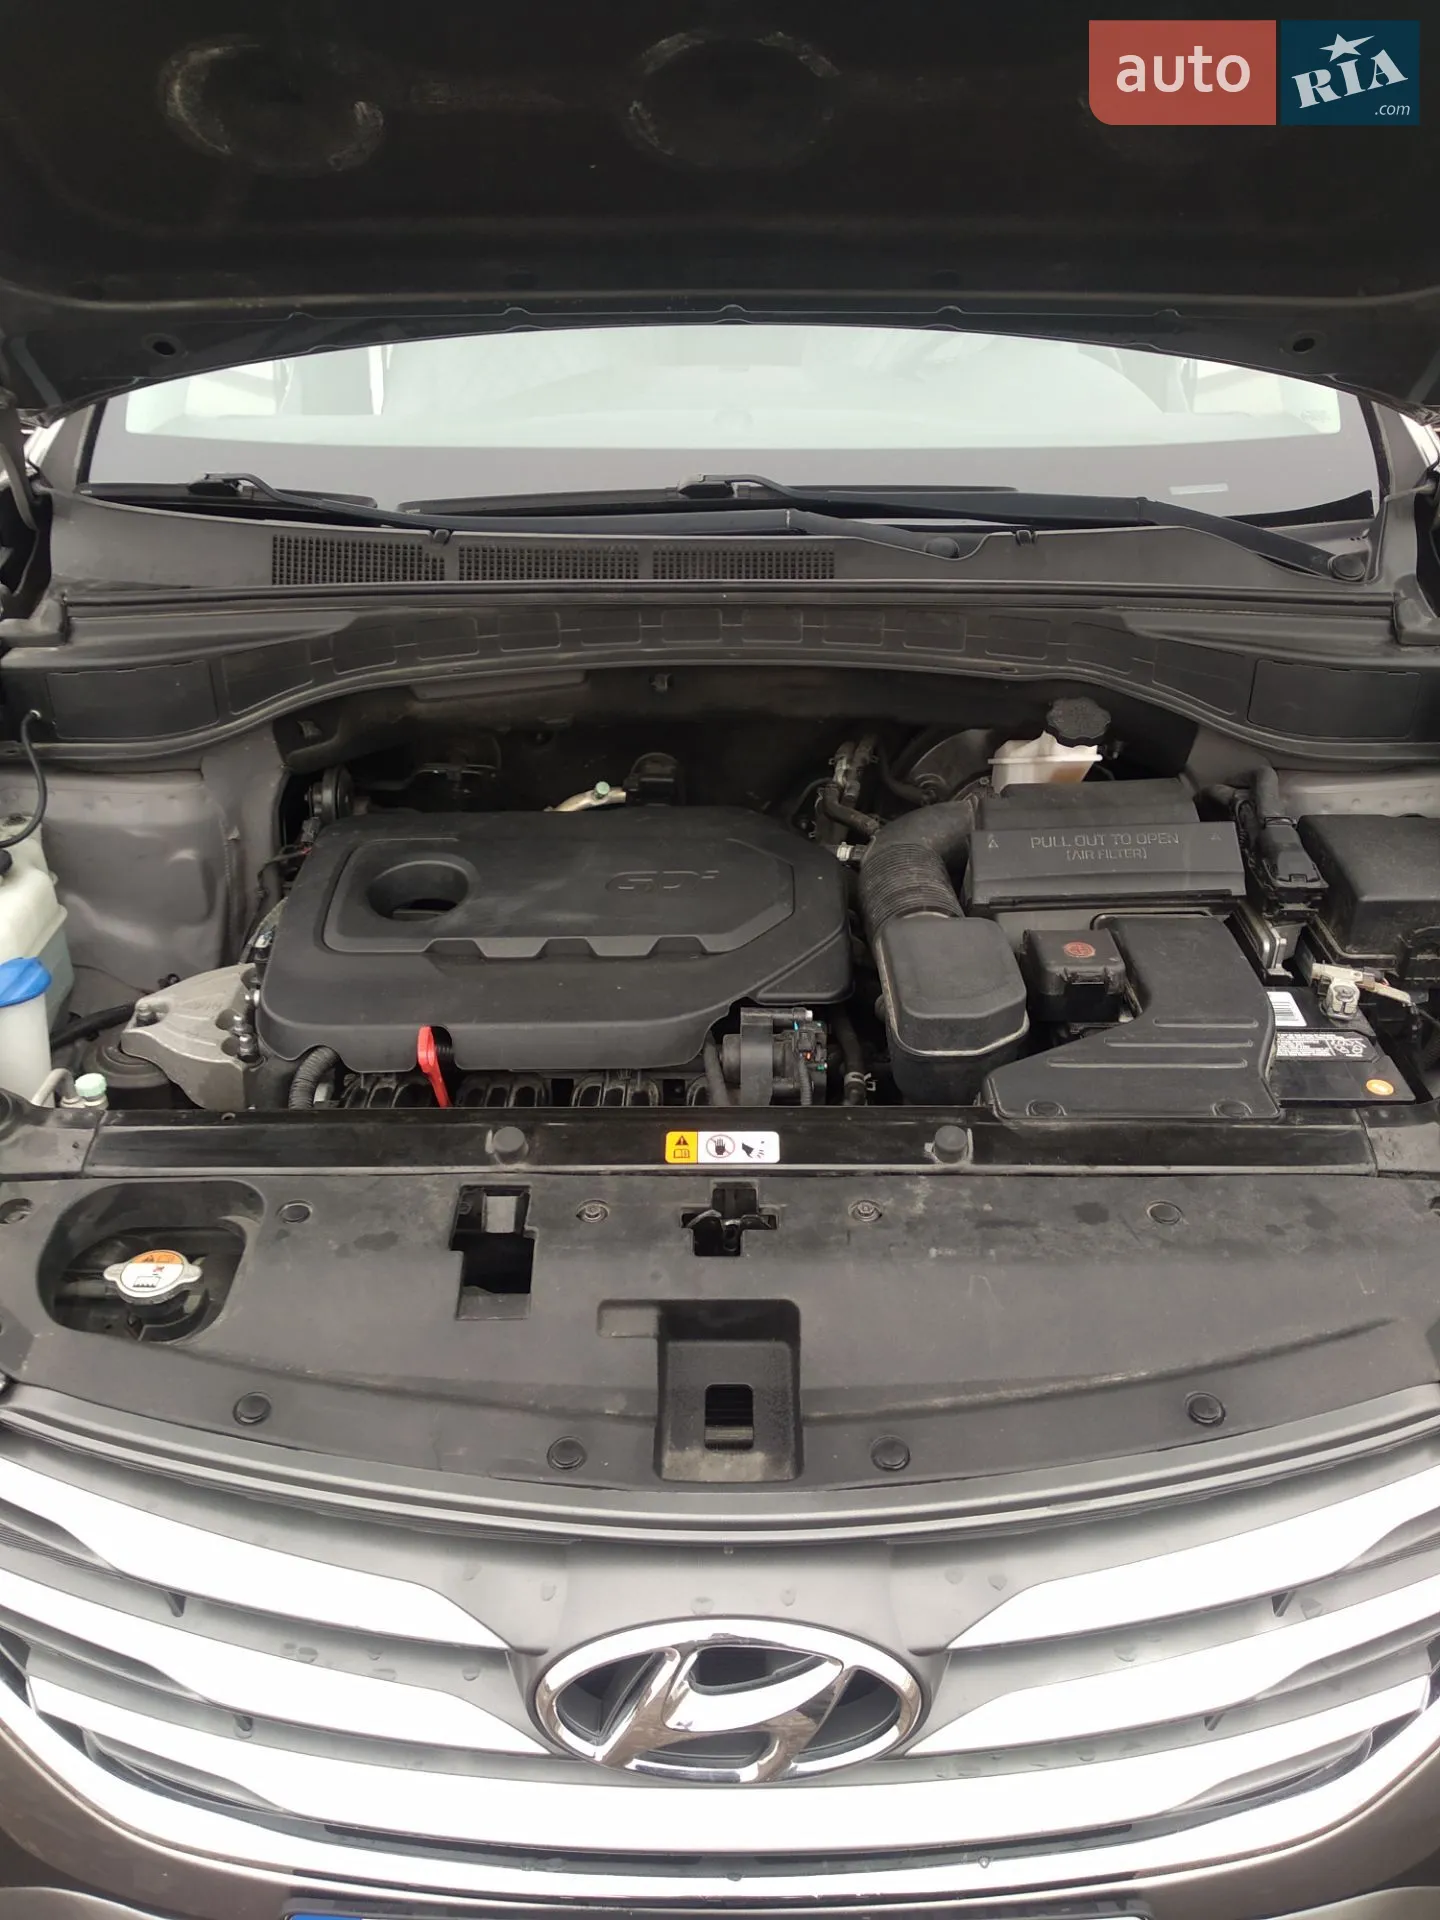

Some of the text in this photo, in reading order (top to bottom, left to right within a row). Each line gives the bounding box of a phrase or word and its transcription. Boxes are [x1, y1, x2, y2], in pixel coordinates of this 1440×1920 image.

[1030, 832, 1179, 849] PULL OUT TO OPEN
